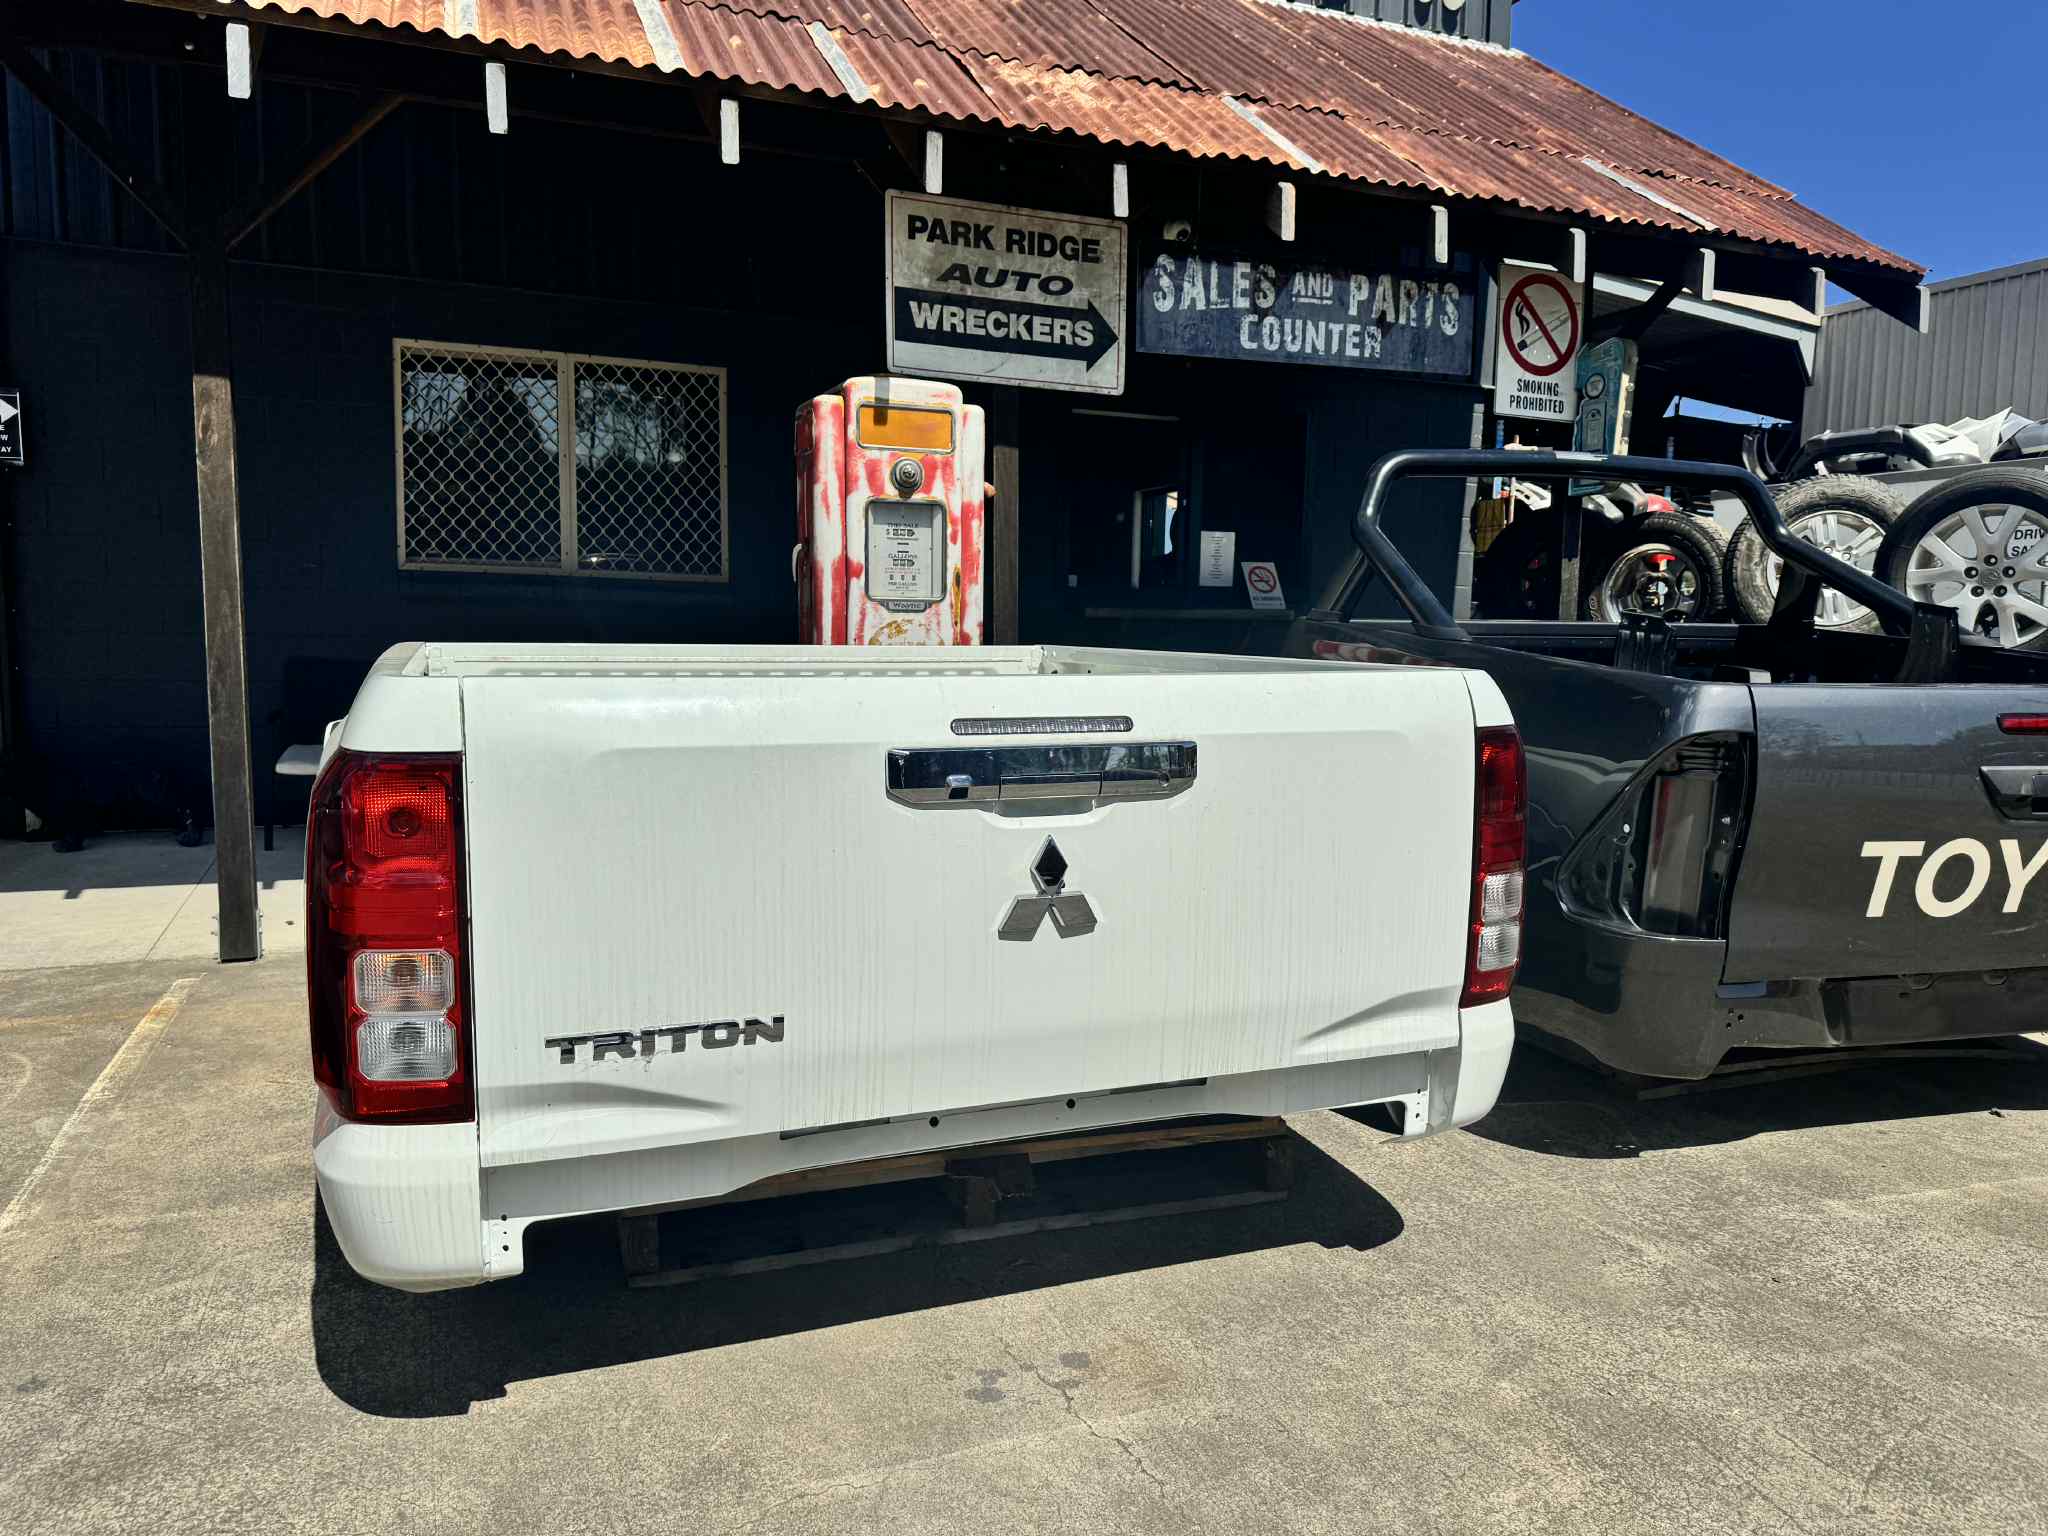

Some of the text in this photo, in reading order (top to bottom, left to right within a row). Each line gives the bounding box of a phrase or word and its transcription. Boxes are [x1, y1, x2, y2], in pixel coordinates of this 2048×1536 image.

[907, 214, 1101, 264] PARK RIDGE
[936, 263, 1073, 296] AUTO
[1153, 254, 1460, 336] SALES AND PARTS
[909, 301, 1095, 347] WRECKERS
[1240, 314, 1381, 358] COUNTER
[1509, 394, 1565, 414] PROHIBITED
[1516, 378, 1559, 396] SMOKING
[1861, 837, 2048, 917] TOY
[544, 1014, 785, 1064] TRITON
